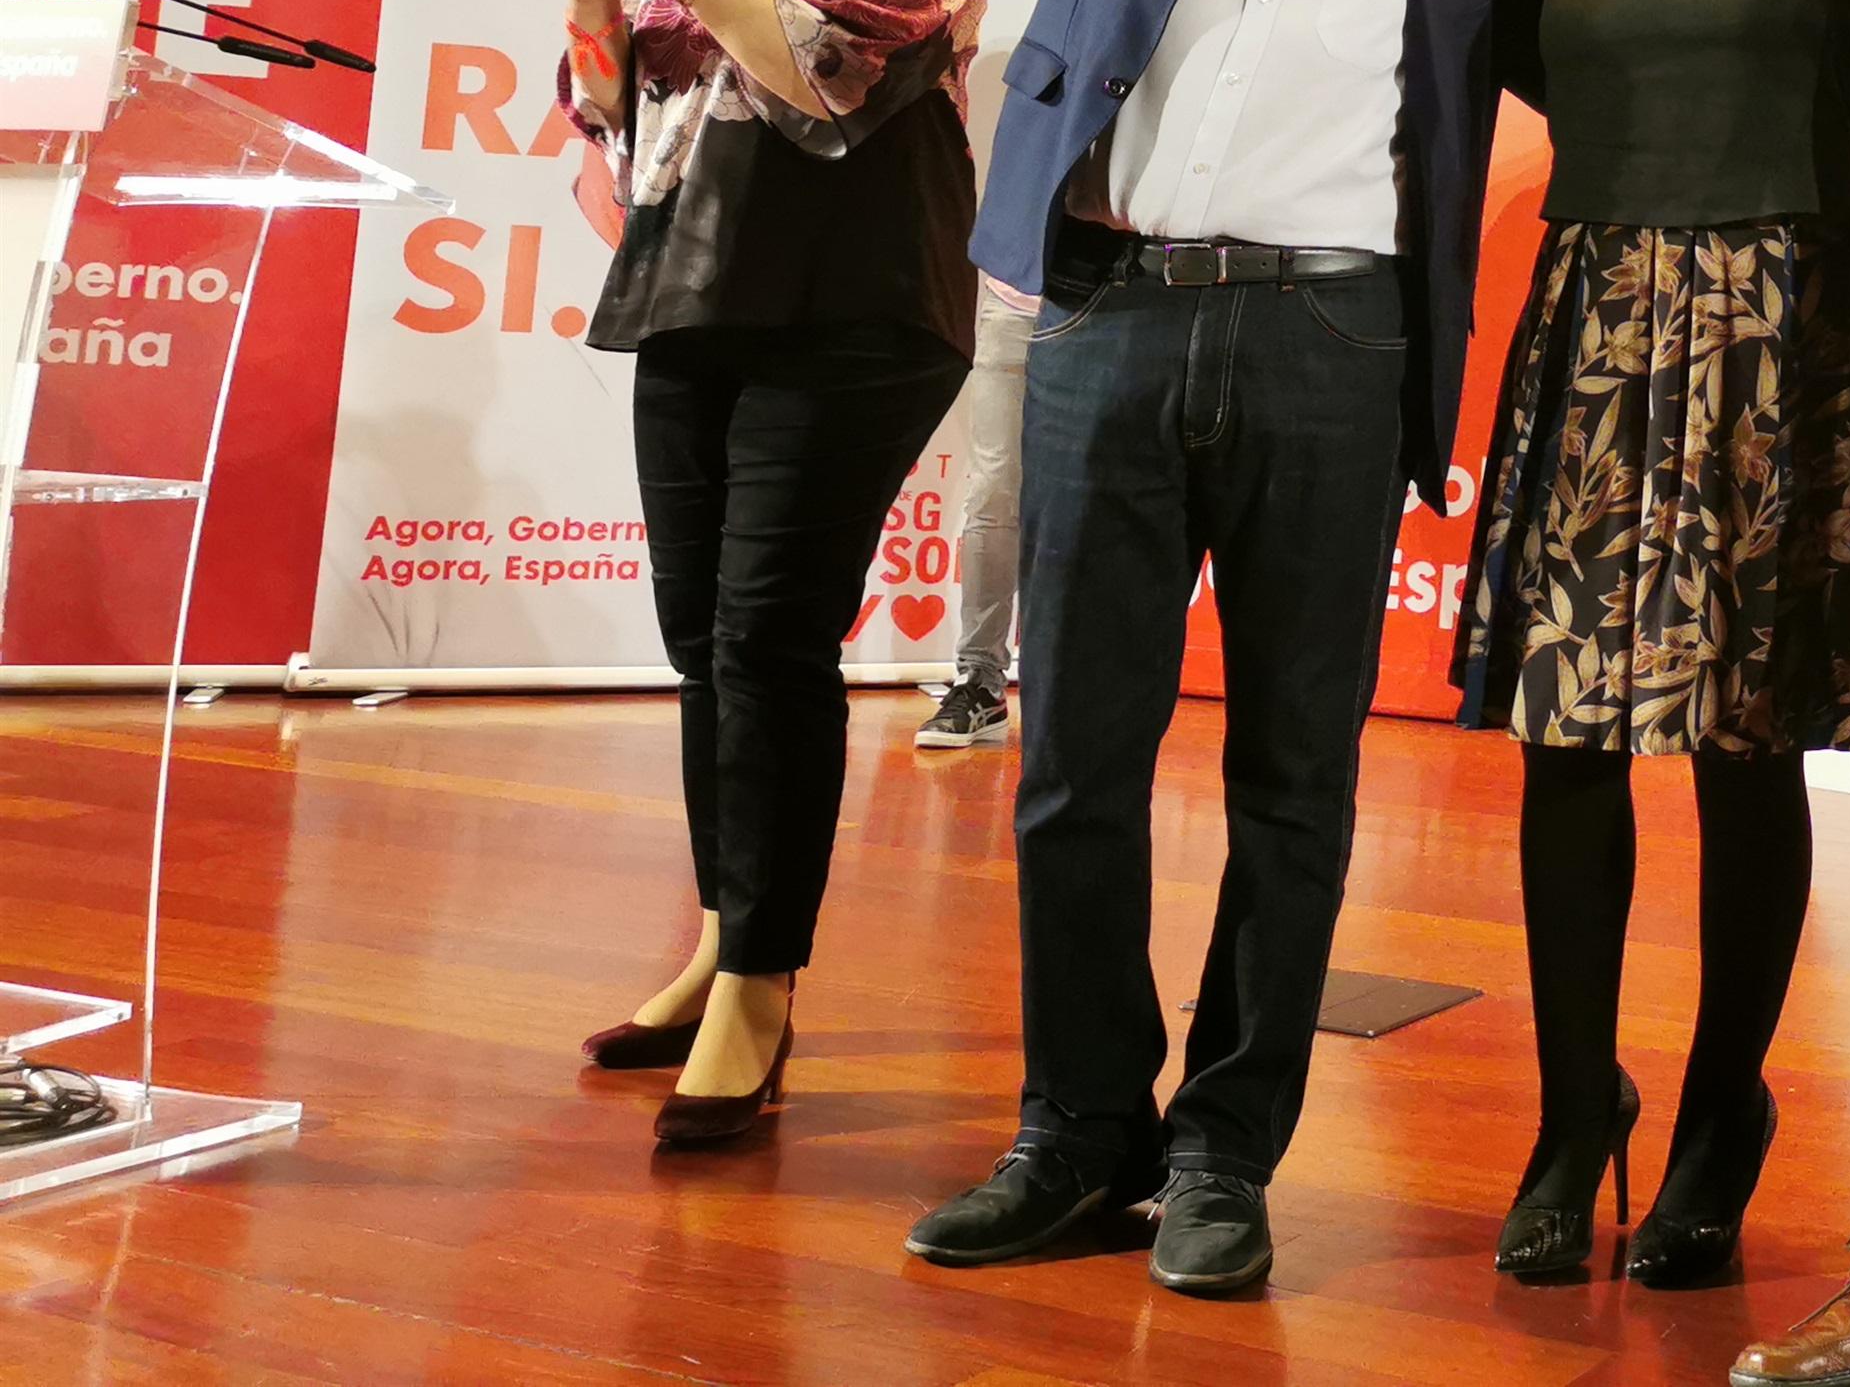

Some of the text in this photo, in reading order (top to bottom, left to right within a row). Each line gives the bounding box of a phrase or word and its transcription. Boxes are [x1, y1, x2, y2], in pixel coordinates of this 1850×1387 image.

[393, 217, 587, 337] SI.
[364, 515, 494, 547] Agora,
[361, 553, 640, 587] Agora, España
